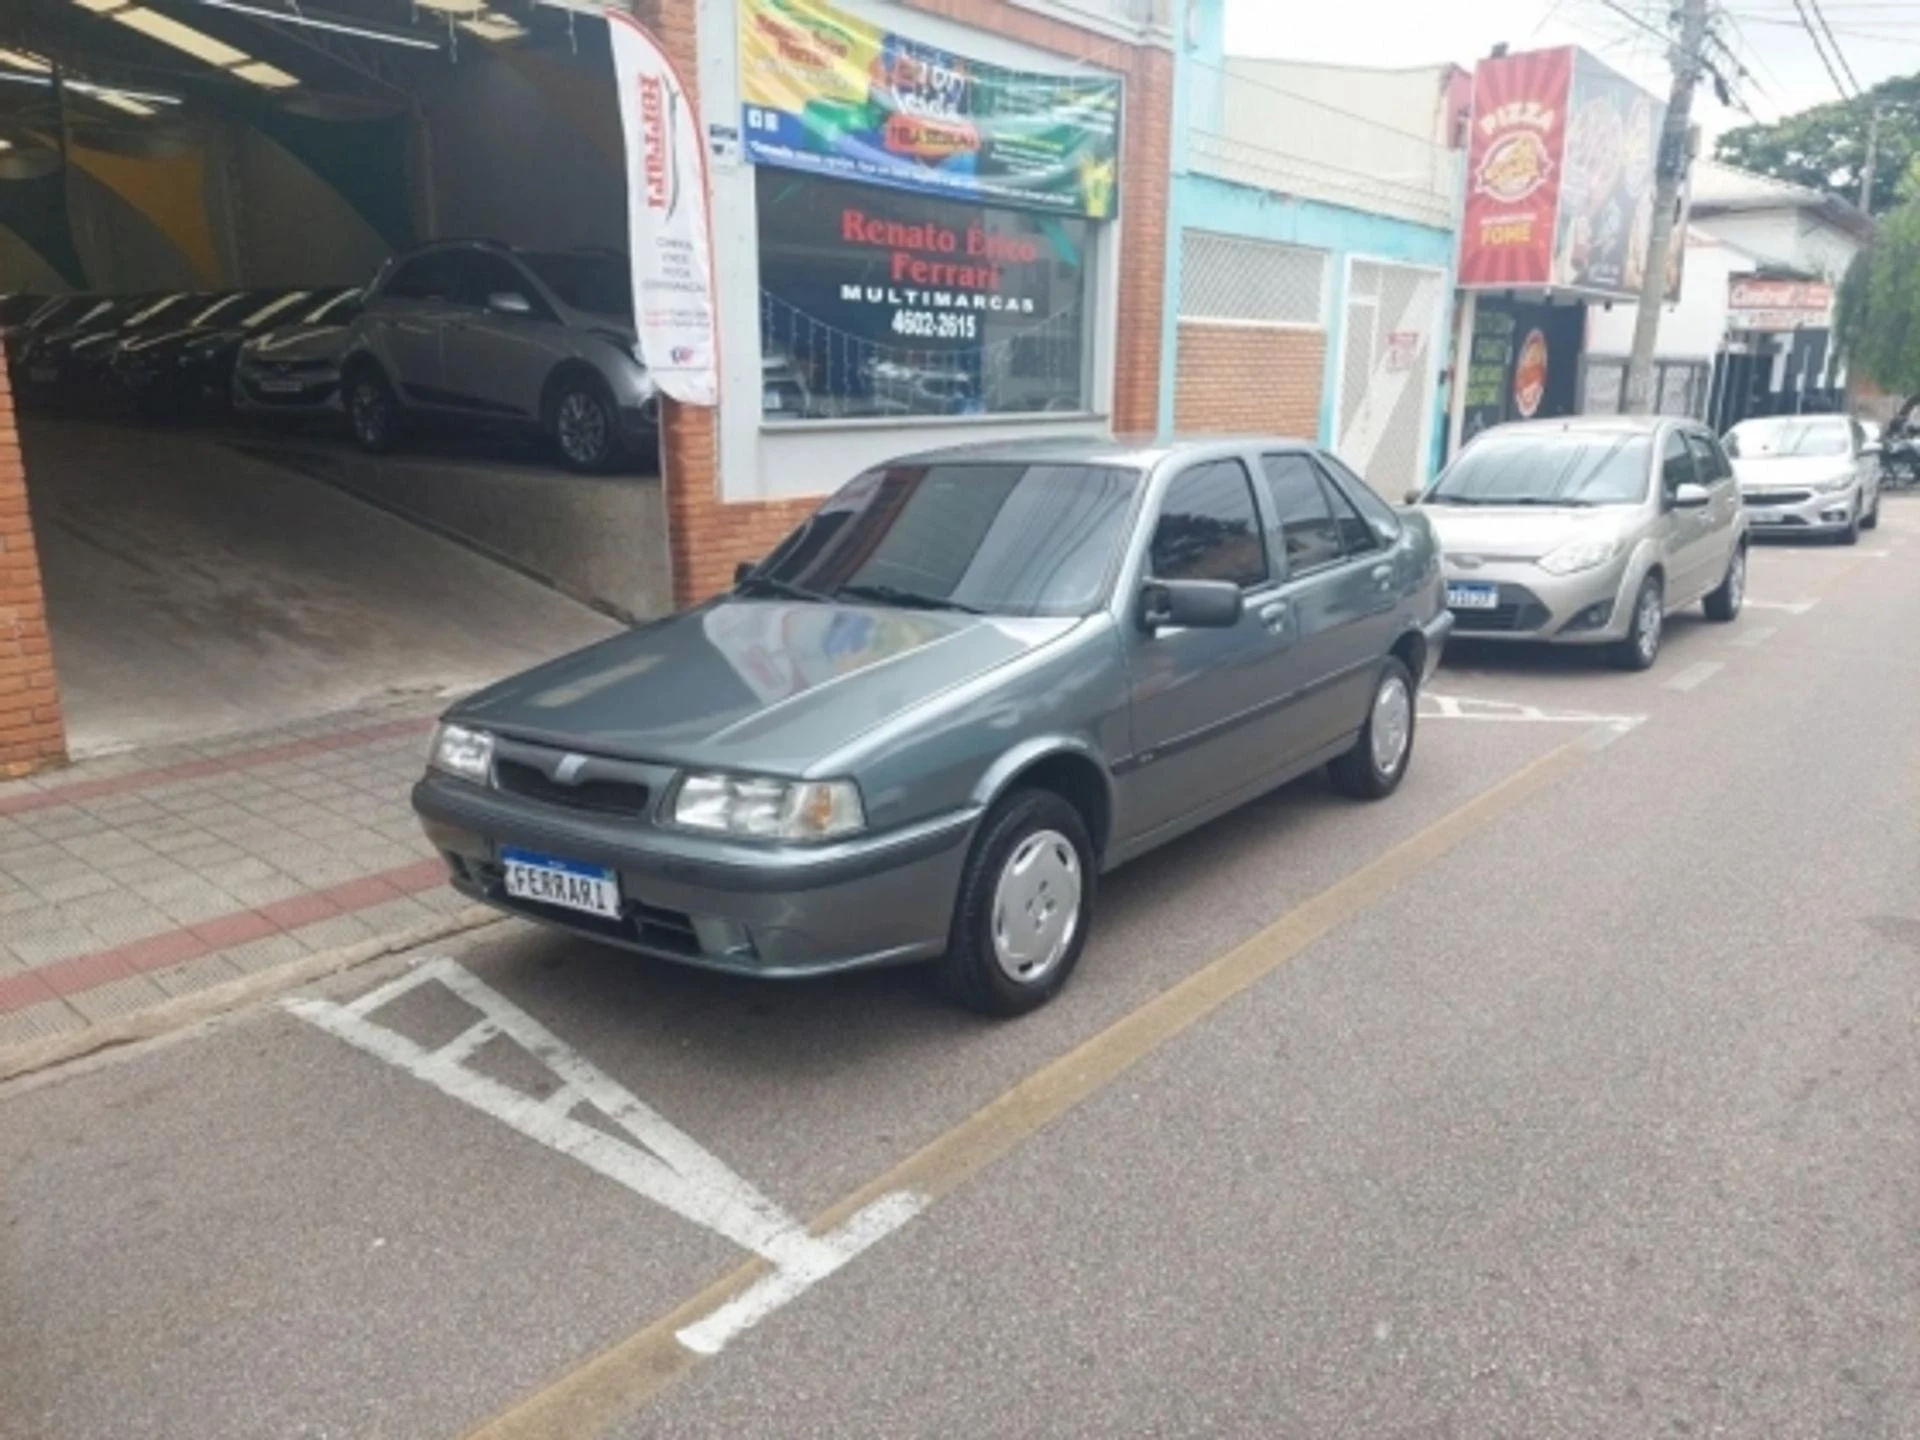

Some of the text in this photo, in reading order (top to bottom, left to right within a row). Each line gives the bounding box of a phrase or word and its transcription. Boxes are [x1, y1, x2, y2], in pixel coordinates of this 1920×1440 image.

[841, 208, 956, 253] Renato
[889, 251, 1001, 289] Ferrari
[840, 284, 1034, 313] MULTIMARCAS
[514, 863, 606, 911] FERRARI
